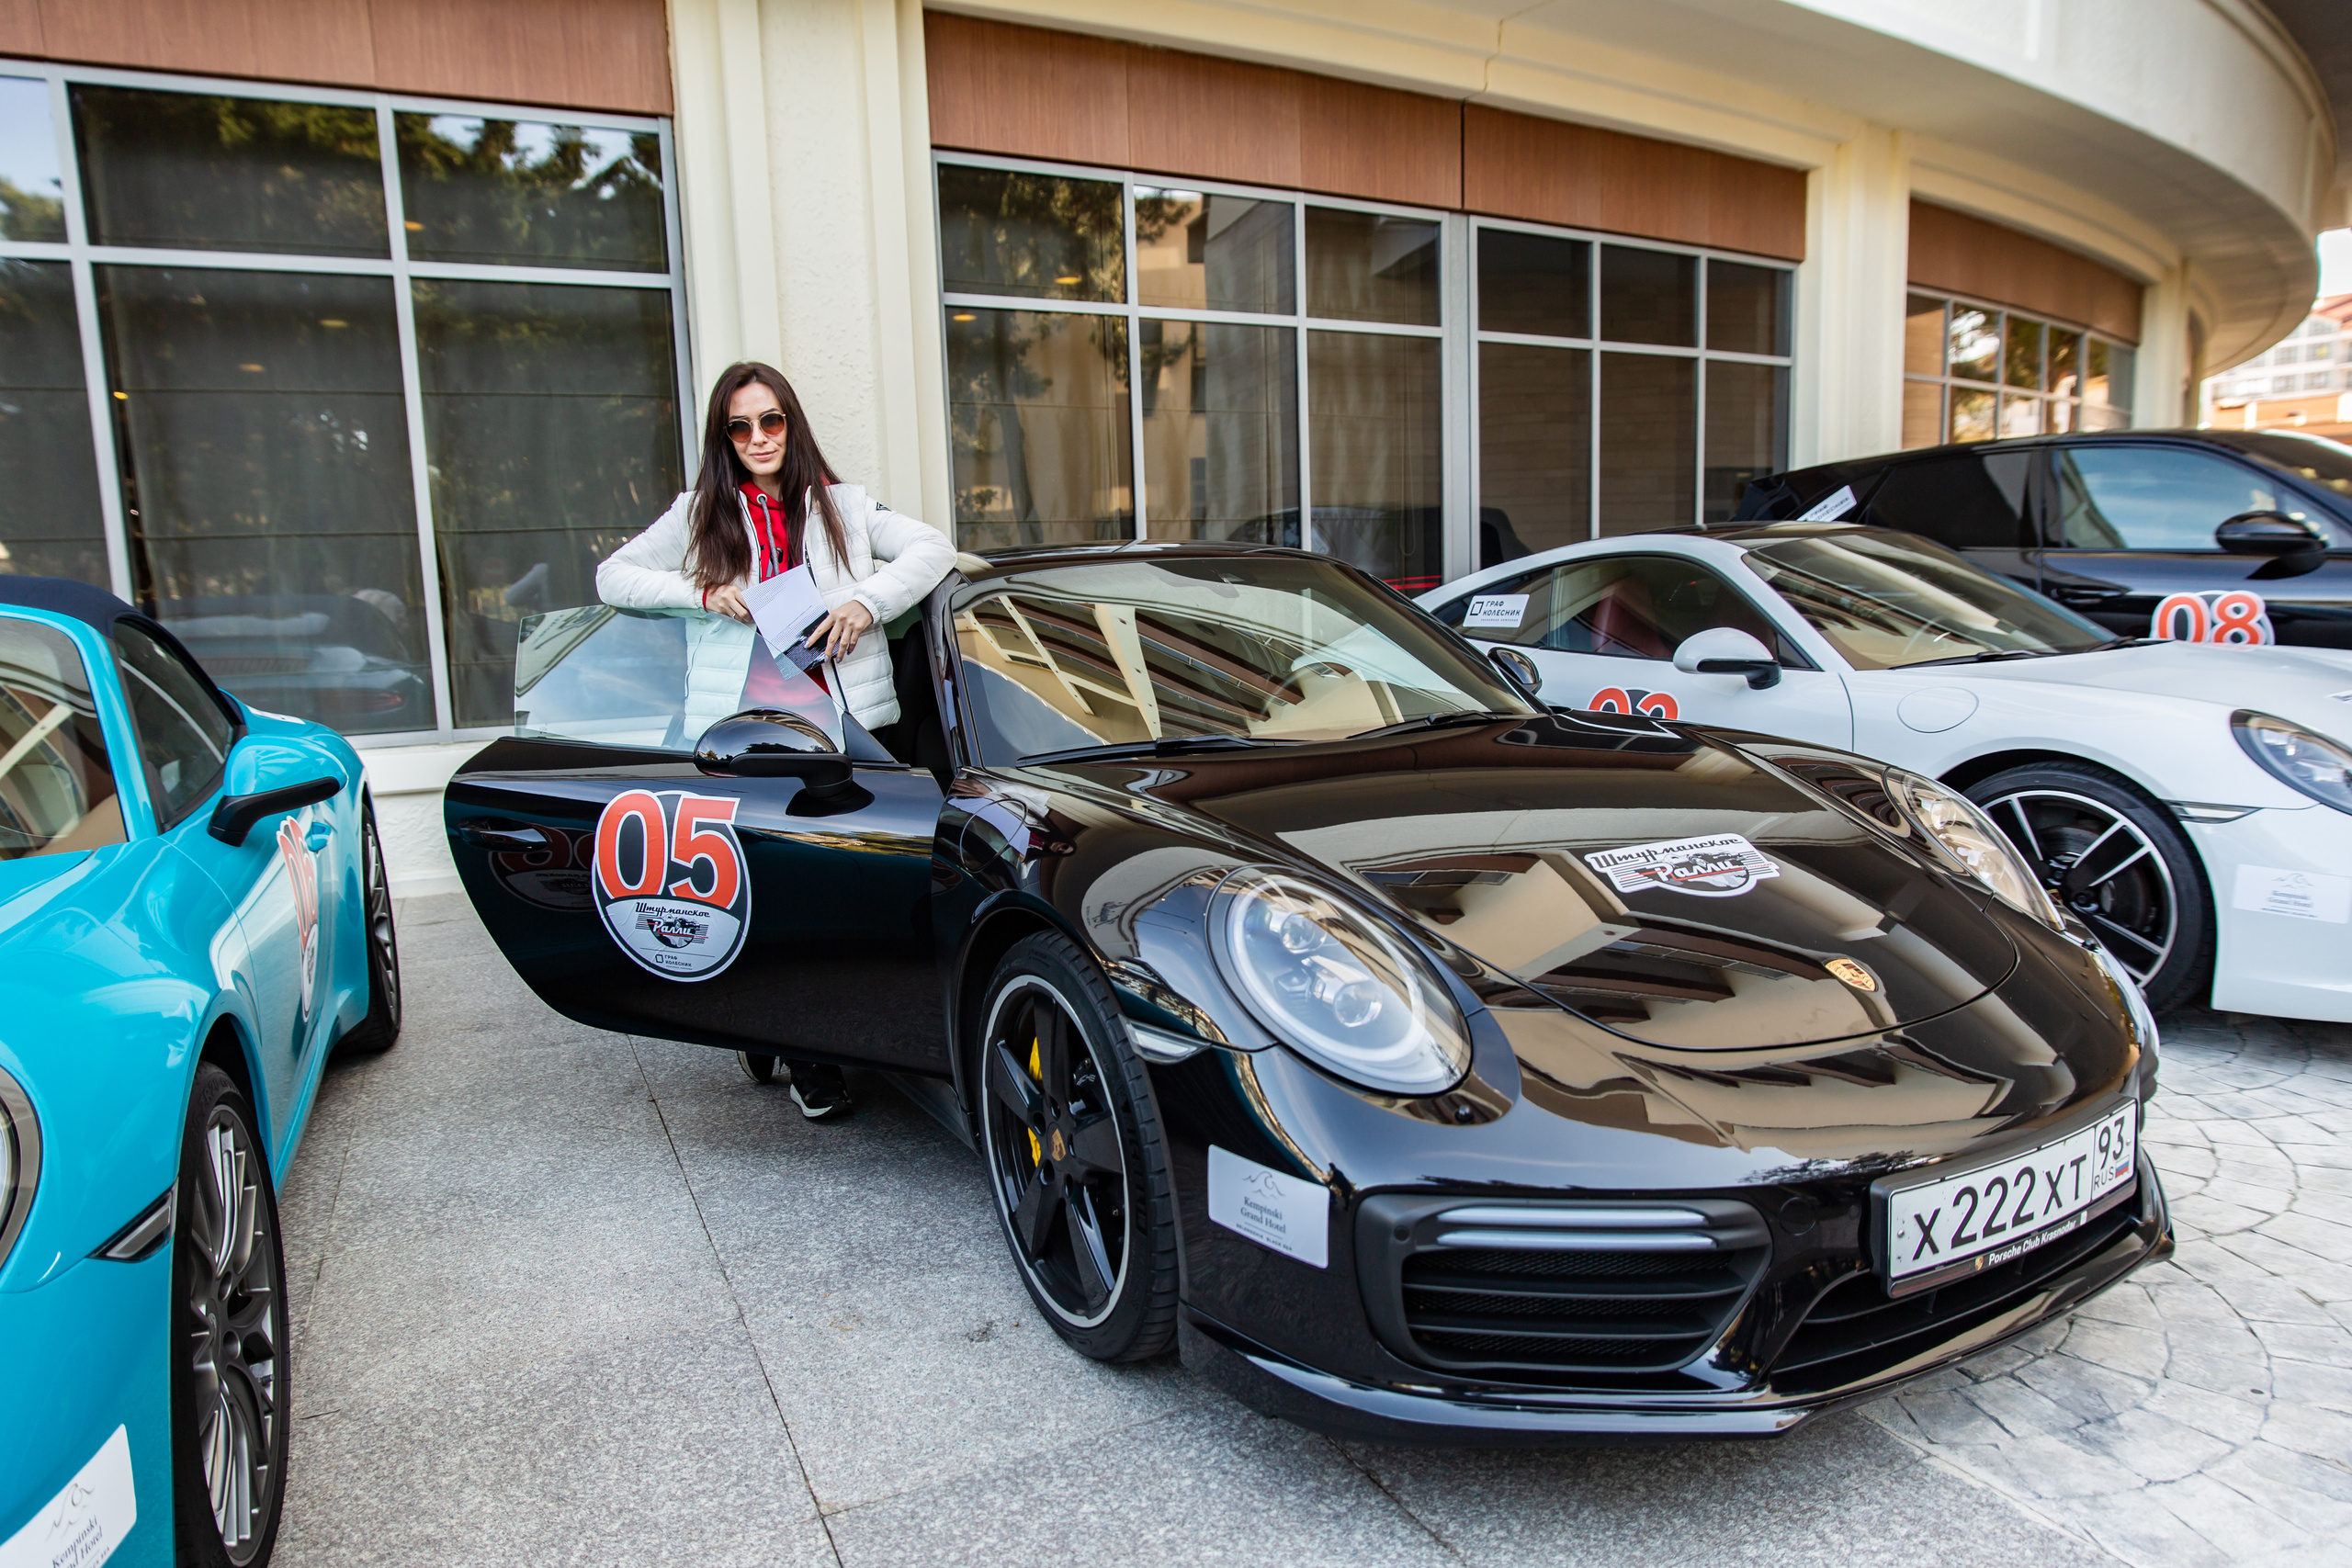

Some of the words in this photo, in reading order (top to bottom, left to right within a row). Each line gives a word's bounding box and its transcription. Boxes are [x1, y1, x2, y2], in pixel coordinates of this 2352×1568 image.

[2155, 592, 2263, 646] 08
[597, 791, 741, 910] 05
[1591, 838, 1745, 869] Штурманское
[1645, 859, 1740, 882] Ралли
[635, 902, 711, 918] Штурманское
[652, 919, 695, 935] Ралли
[2098, 1115, 2126, 1170] 93
[2093, 1169, 2115, 1191] RUS
[1239, 1207, 1263, 1224] Grand
[1264, 1217, 1286, 1234] Hotel
[1243, 1196, 1283, 1221] Kempinski
[1988, 1245, 2022, 1266] Porsche
[2022, 1235, 2041, 1252] Club
[2041, 1219, 2076, 1244] Krasnodar
[51, 1514, 98, 1568] Kempinski
[80, 1525, 103, 1560] Hotel
